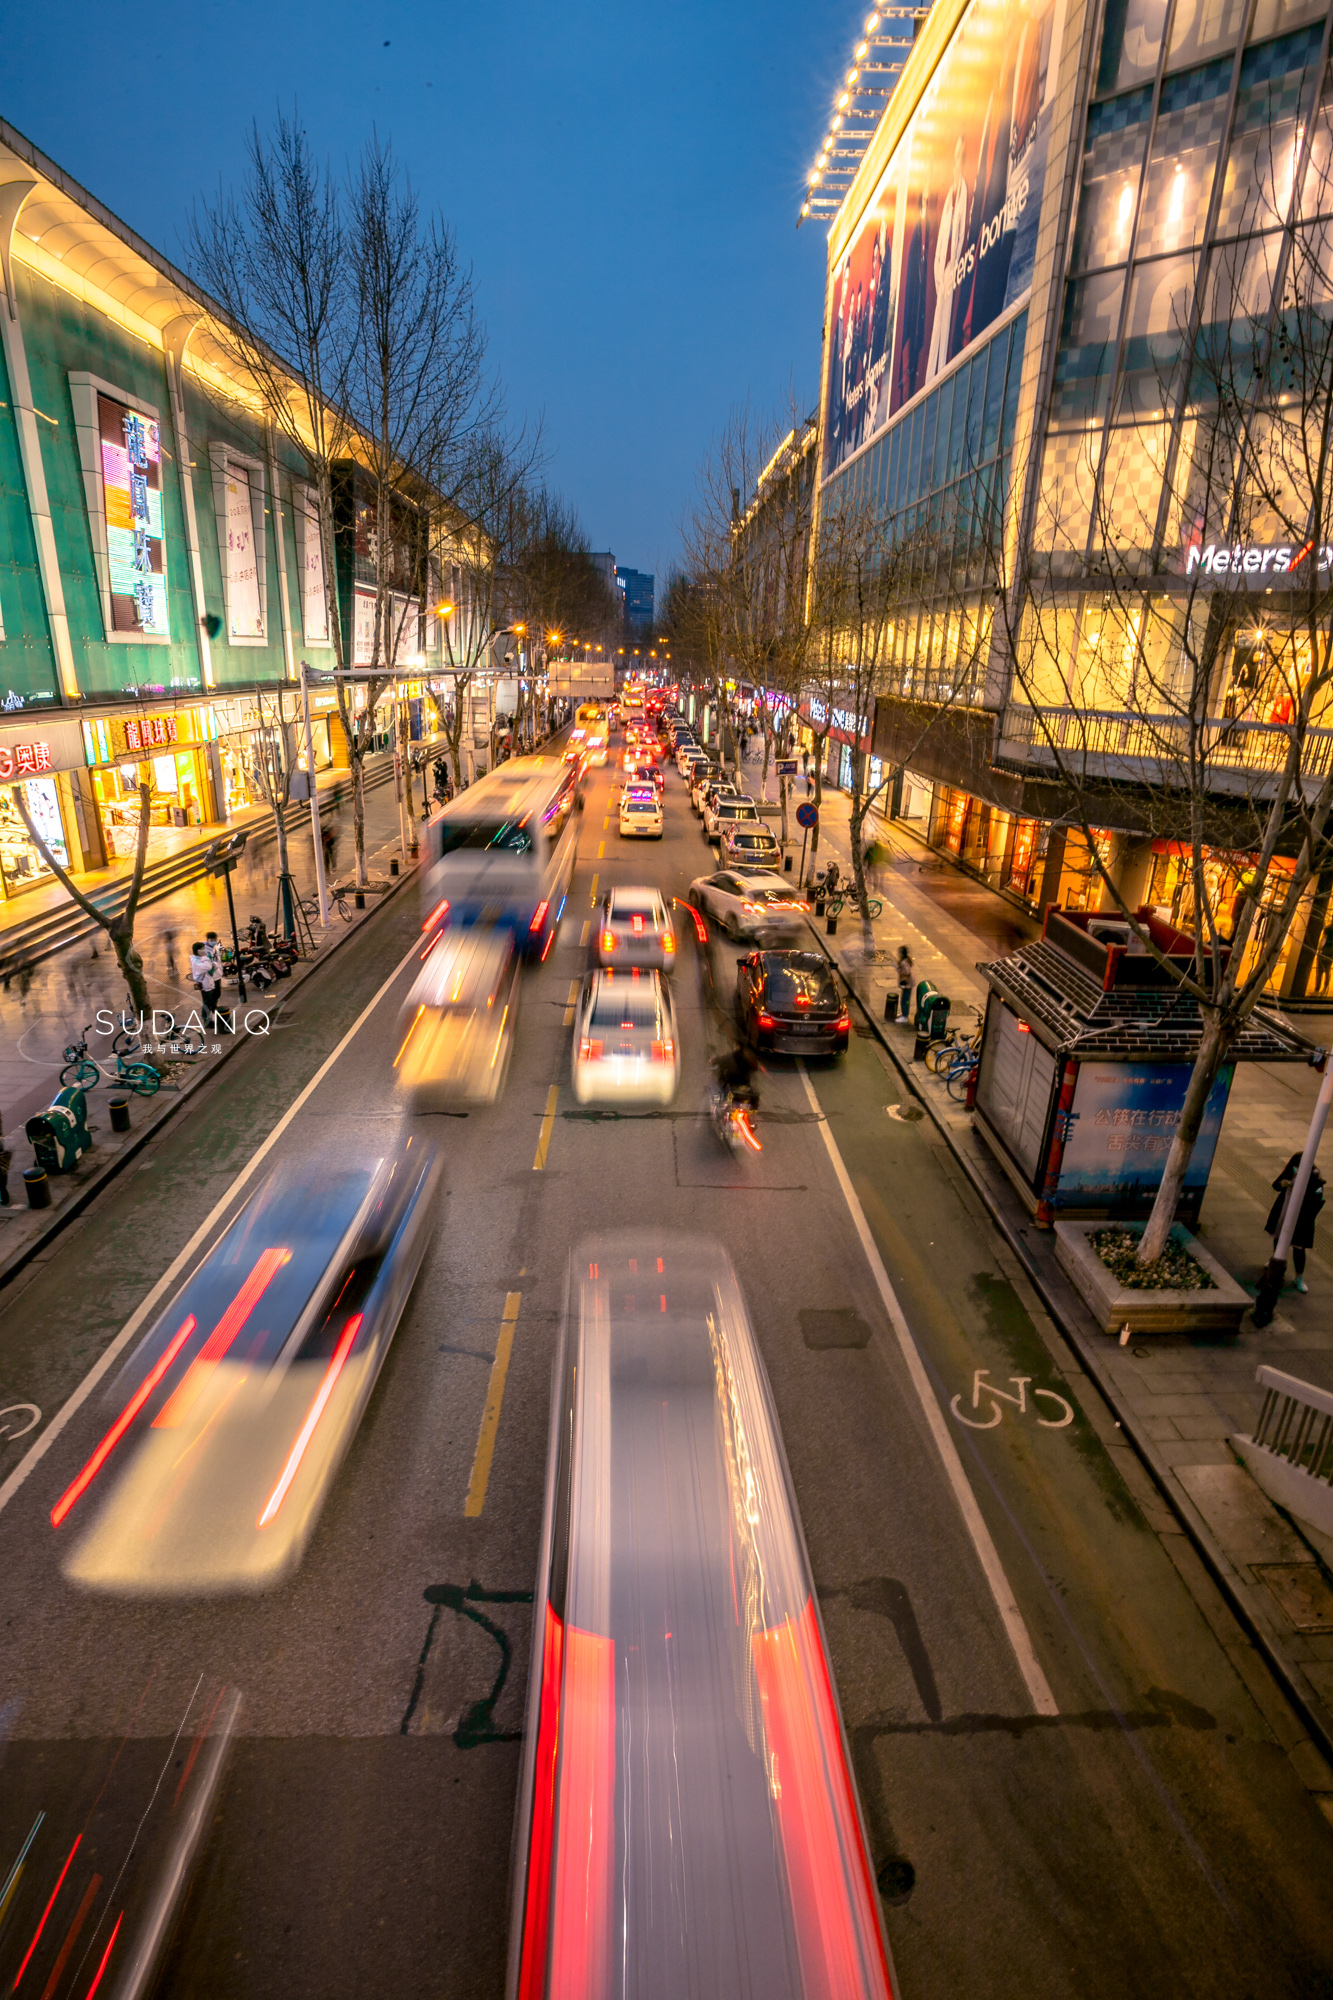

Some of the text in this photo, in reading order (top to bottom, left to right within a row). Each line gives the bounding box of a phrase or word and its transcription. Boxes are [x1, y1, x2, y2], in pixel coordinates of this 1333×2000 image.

[1185, 544, 1292, 575] Meters
[125, 716, 179, 751] 龍鳳珠寶
[16, 741, 53, 776] 奥康
